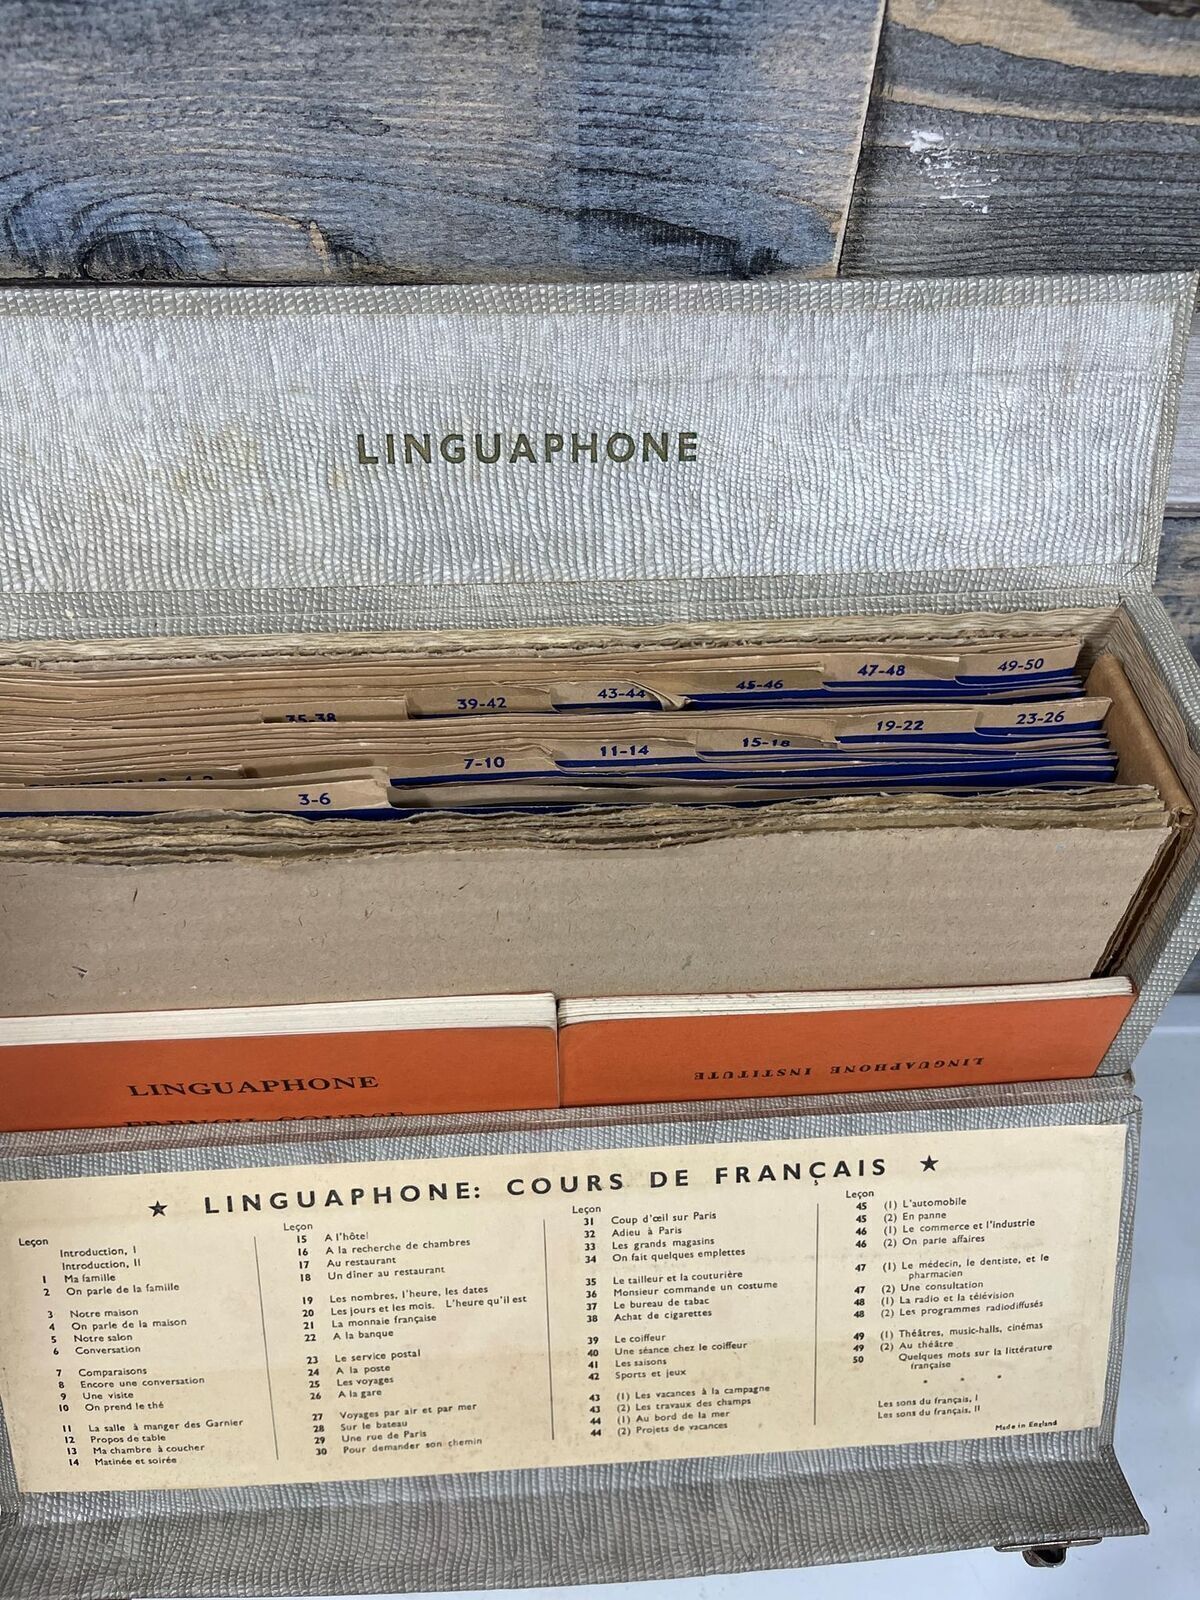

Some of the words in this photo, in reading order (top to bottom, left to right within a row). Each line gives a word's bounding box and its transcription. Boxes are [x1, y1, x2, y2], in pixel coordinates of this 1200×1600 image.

[356, 432, 698, 465] LINGUAPHONE
[858, 664, 906, 677] 47-48
[997, 657, 1044, 673] 49-50
[736, 679, 783, 689] 45-46
[597, 688, 646, 699] 43-44
[457, 697, 507, 710] 39-42
[1016, 711, 1065, 725] 23-26
[877, 720, 924, 732] 19-22
[742, 737, 790, 747] 15-18
[600, 744, 649, 757] 11-14
[464, 757, 506, 769] 7-10
[299, 793, 331, 806] 3-6
[830, 1057, 984, 1074] LINGUAPHONE
[694, 1067, 811, 1080] INSTITUTE
[127, 1076, 379, 1097] LINGUAPHONE
[204, 1181, 480, 1214] LINGUAPHONE:
[507, 1173, 623, 1196] COURS
[650, 1168, 689, 1189] DE
[715, 1158, 886, 1186] FRANÇAIS
[845, 1189, 874, 1200] Leçon
[572, 1205, 601, 1215] Leçon
[855, 1201, 867, 1211] 45
[883, 1199, 897, 1212] (1)
[583, 1216, 593, 1226] 31
[610, 1215, 638, 1226] Coup
[672, 1214, 688, 1222] sur
[693, 1211, 716, 1220] Paris
[283, 1222, 313, 1233] Leçon
[855, 1226, 867, 1236] 46
[883, 1223, 897, 1237] (1)
[902, 1224, 914, 1233] Le
[919, 1223, 970, 1232] commerce
[972, 1222, 983, 1230] et
[18, 1237, 48, 1248] Leçon
[296, 1234, 307, 1243] 15
[324, 1233, 333, 1242] A
[335, 1231, 368, 1241] l'hôtel
[584, 1242, 596, 1251] 33
[612, 1241, 628, 1250] Les
[633, 1238, 667, 1251] grands
[672, 1237, 715, 1248] magasins
[298, 1260, 309, 1269] 17
[326, 1258, 341, 1268] Au
[344, 1256, 396, 1267] restaurant
[584, 1254, 596, 1264] 34
[612, 1253, 628, 1262] On
[631, 1252, 648, 1262] fait
[650, 1248, 694, 1262] quelques
[697, 1248, 745, 1259] emplettes
[42, 1275, 46, 1284] 1
[64, 1273, 79, 1283] Ma
[81, 1272, 116, 1283] famille
[585, 1287, 597, 1298] 36
[613, 1286, 659, 1298] Monsieur
[663, 1283, 715, 1294] commande
[737, 1282, 777, 1290] costume
[853, 1285, 866, 1294] 47
[881, 1283, 895, 1295] (2)
[900, 1283, 920, 1292] Une
[924, 1279, 983, 1291] consultation
[302, 1295, 313, 1305] 19
[329, 1294, 346, 1303] Les
[444, 1287, 458, 1295] les
[462, 1285, 488, 1294] dates
[47, 1310, 55, 1318] 3
[69, 1309, 100, 1319] Notre
[103, 1308, 138, 1318] maison
[586, 1314, 598, 1323] 38
[613, 1312, 642, 1322] Achat
[646, 1310, 659, 1319] de
[664, 1308, 712, 1320] cigarettes
[853, 1309, 865, 1318] 48
[880, 1308, 894, 1319] (2)
[899, 1307, 916, 1316] Les
[920, 1304, 980, 1317] programmes
[985, 1299, 1043, 1312] radiodiffusés
[302, 1320, 314, 1330] 21
[331, 1319, 343, 1328] La
[347, 1316, 390, 1327] monnaie
[393, 1313, 436, 1324] française
[50, 1335, 56, 1343] 5
[73, 1332, 104, 1343] Notre
[107, 1332, 133, 1342] salon
[852, 1331, 865, 1341] 49
[880, 1329, 894, 1341] (1)
[1006, 1321, 1043, 1332] cinémas
[587, 1335, 599, 1345] 39
[614, 1335, 626, 1343] Le
[628, 1333, 666, 1343] coiffeur
[852, 1341, 864, 1352] 49
[879, 1341, 894, 1352] (2)
[898, 1339, 913, 1350] Au
[917, 1339, 953, 1349] théâtre
[52, 1346, 59, 1355] 6
[74, 1344, 140, 1355] Conversation
[852, 1355, 864, 1364] 50
[898, 1350, 943, 1362] Quelques
[947, 1350, 970, 1358] mots
[993, 1347, 1002, 1356] la
[1005, 1344, 1052, 1355] littérature
[305, 1355, 318, 1365] 23
[334, 1354, 347, 1363] Le
[350, 1352, 386, 1362] service
[390, 1348, 420, 1361] postal
[910, 1360, 951, 1370] française
[55, 1368, 61, 1377] 7
[78, 1367, 147, 1380] Comparaisons
[587, 1371, 600, 1381] 42
[615, 1371, 646, 1381] Sports
[665, 1368, 686, 1378] jeux
[58, 1380, 64, 1389] 8
[79, 1377, 114, 1388] Encore
[141, 1376, 205, 1386] conversation
[308, 1379, 320, 1388] 25
[336, 1378, 353, 1387] Les
[355, 1377, 393, 1387] voyages
[62, 1424, 71, 1432] 11
[88, 1424, 100, 1432] La
[103, 1423, 125, 1432] salle
[133, 1422, 138, 1431] à
[143, 1423, 179, 1432] manger
[183, 1420, 200, 1428] des
[205, 1418, 243, 1428] Garnier
[994, 1423, 1015, 1431] Made
[1028, 1419, 1057, 1428] England
[64, 1433, 75, 1445] 12
[90, 1432, 124, 1446] Propos
[126, 1432, 139, 1442] de
[141, 1433, 166, 1442] table
[313, 1435, 325, 1445] 29
[341, 1434, 361, 1443] Une
[386, 1431, 399, 1439] de
[403, 1429, 427, 1439] Paris
